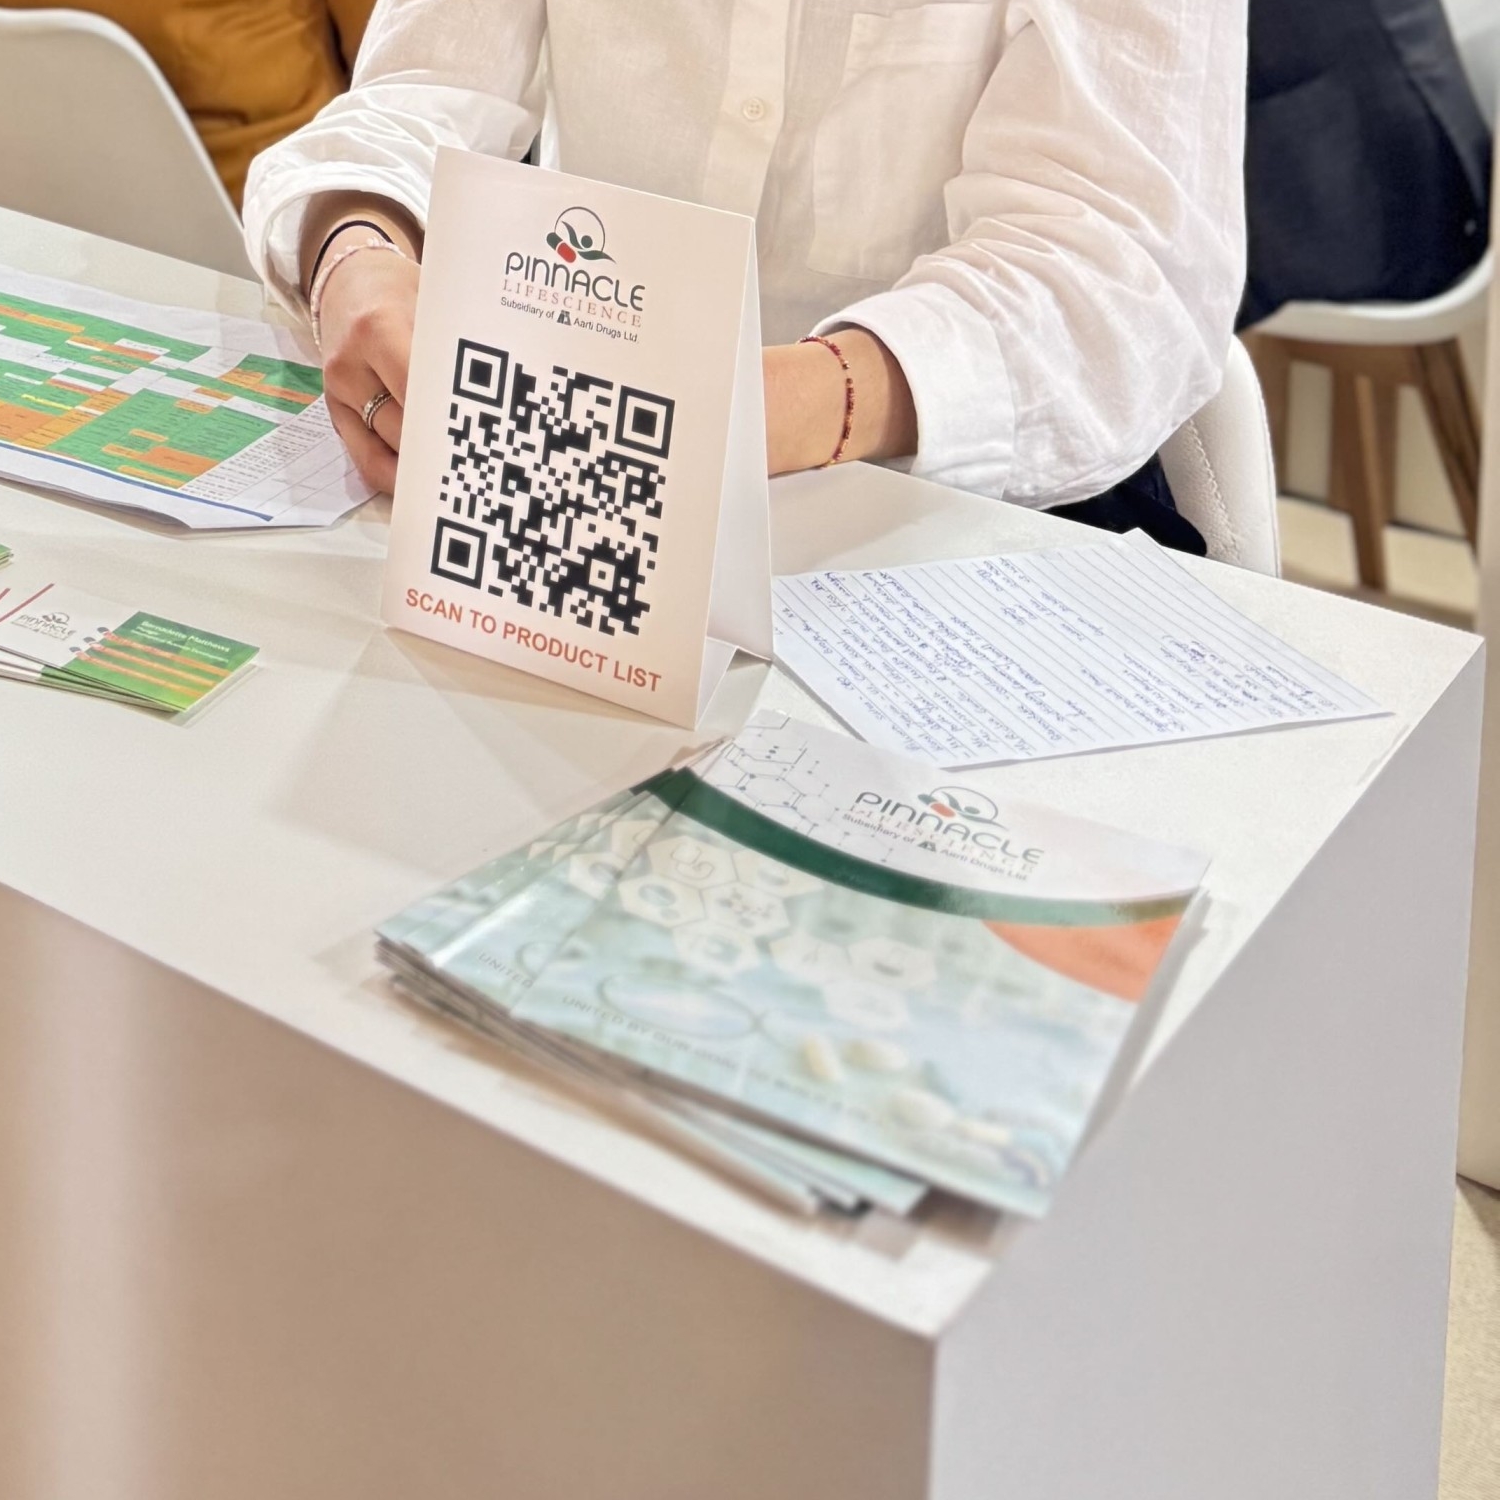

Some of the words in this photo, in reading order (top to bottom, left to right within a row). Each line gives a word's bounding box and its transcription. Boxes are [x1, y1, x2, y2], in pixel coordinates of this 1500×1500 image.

[501, 279, 642, 328] LIFESCIENCE
[504, 252, 646, 312] PINNACLE
[500, 296, 544, 318] Subsidiary
[545, 309, 555, 320] of
[573, 317, 594, 331] Aarti
[595, 322, 621, 339] Drugs
[405, 586, 463, 631] SCAN
[468, 608, 498, 637] TO
[501, 622, 609, 675] PRODUCT
[613, 658, 663, 694] LIST
[842, 813, 901, 841] Subsidiary
[903, 835, 915, 845] of
[970, 857, 1006, 875] Drugs
[855, 791, 1045, 865] PINNACLE
[477, 951, 535, 990] UNITED
[561, 994, 626, 1026] UNITED
[627, 1020, 650, 1037] BY
